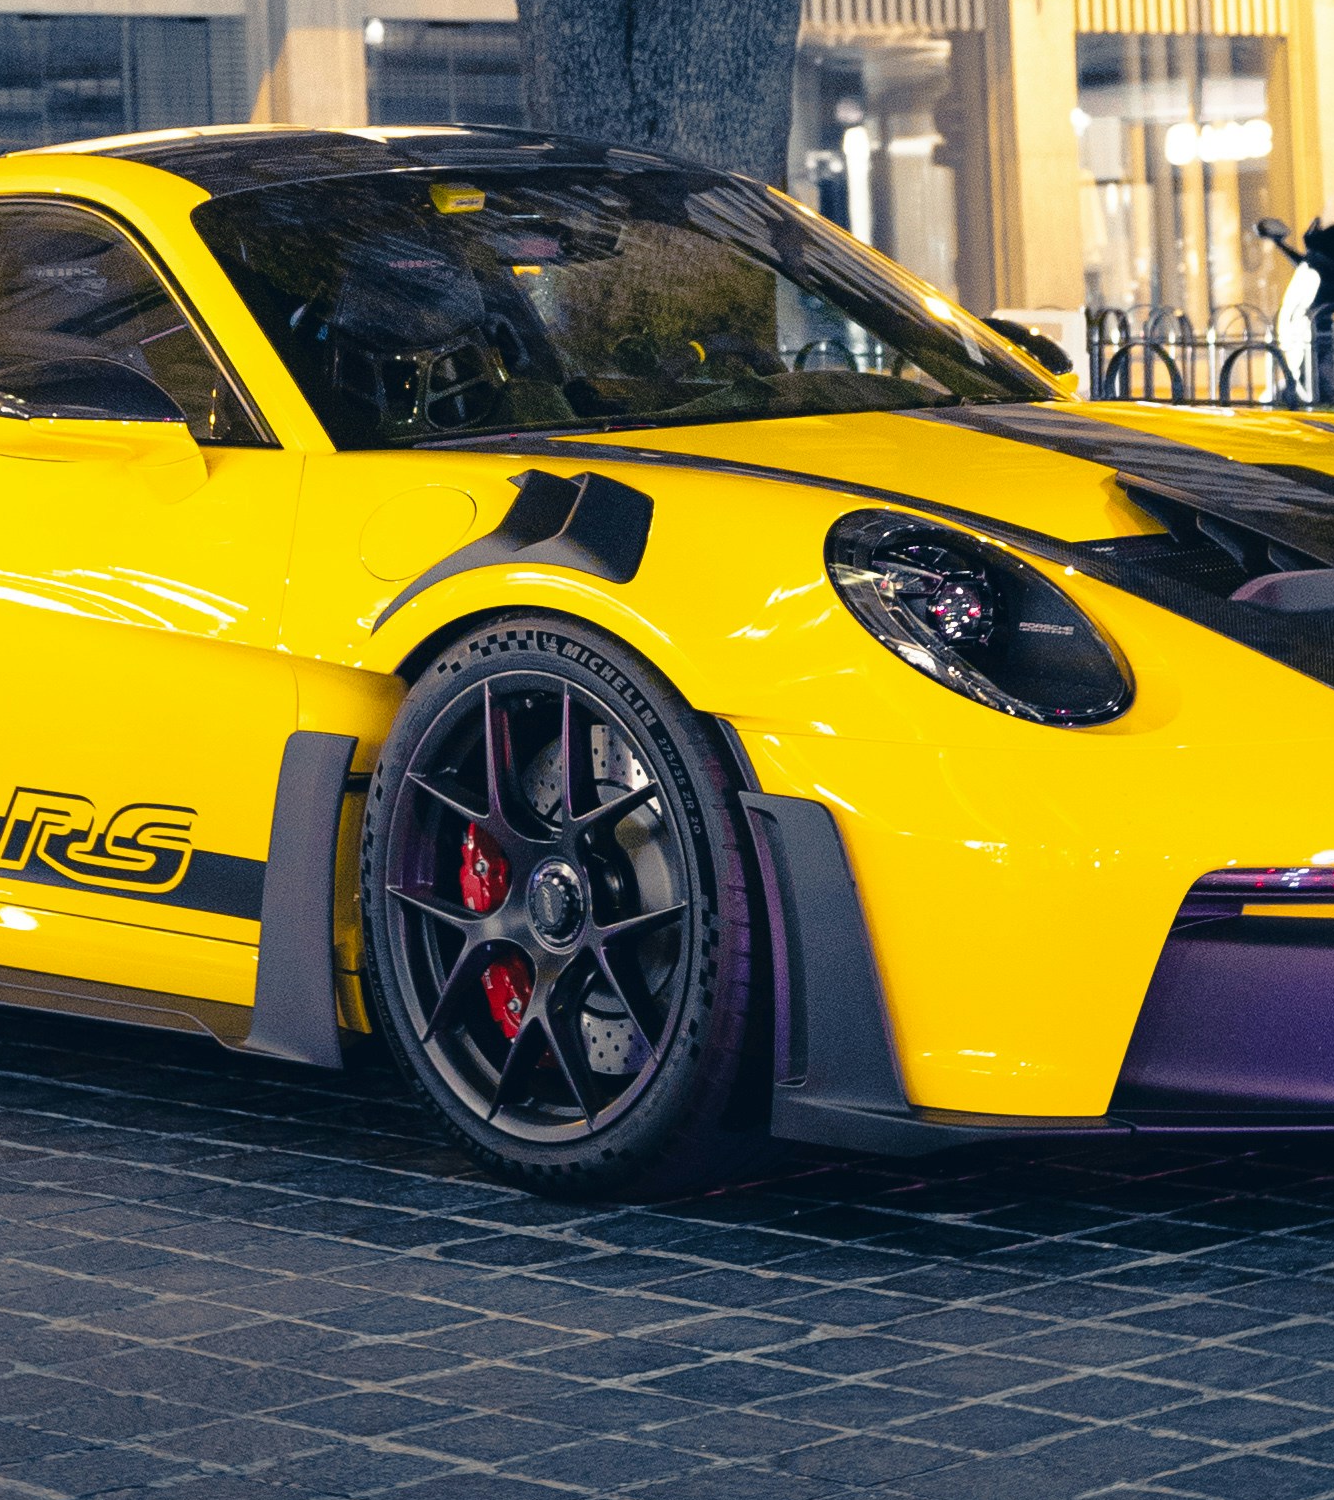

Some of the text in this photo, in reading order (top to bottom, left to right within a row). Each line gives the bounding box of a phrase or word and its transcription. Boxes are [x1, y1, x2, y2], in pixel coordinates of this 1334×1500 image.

[562, 642, 657, 728] MICHELIN
[681, 790, 695, 814] ZR
[688, 815, 701, 835] 20
